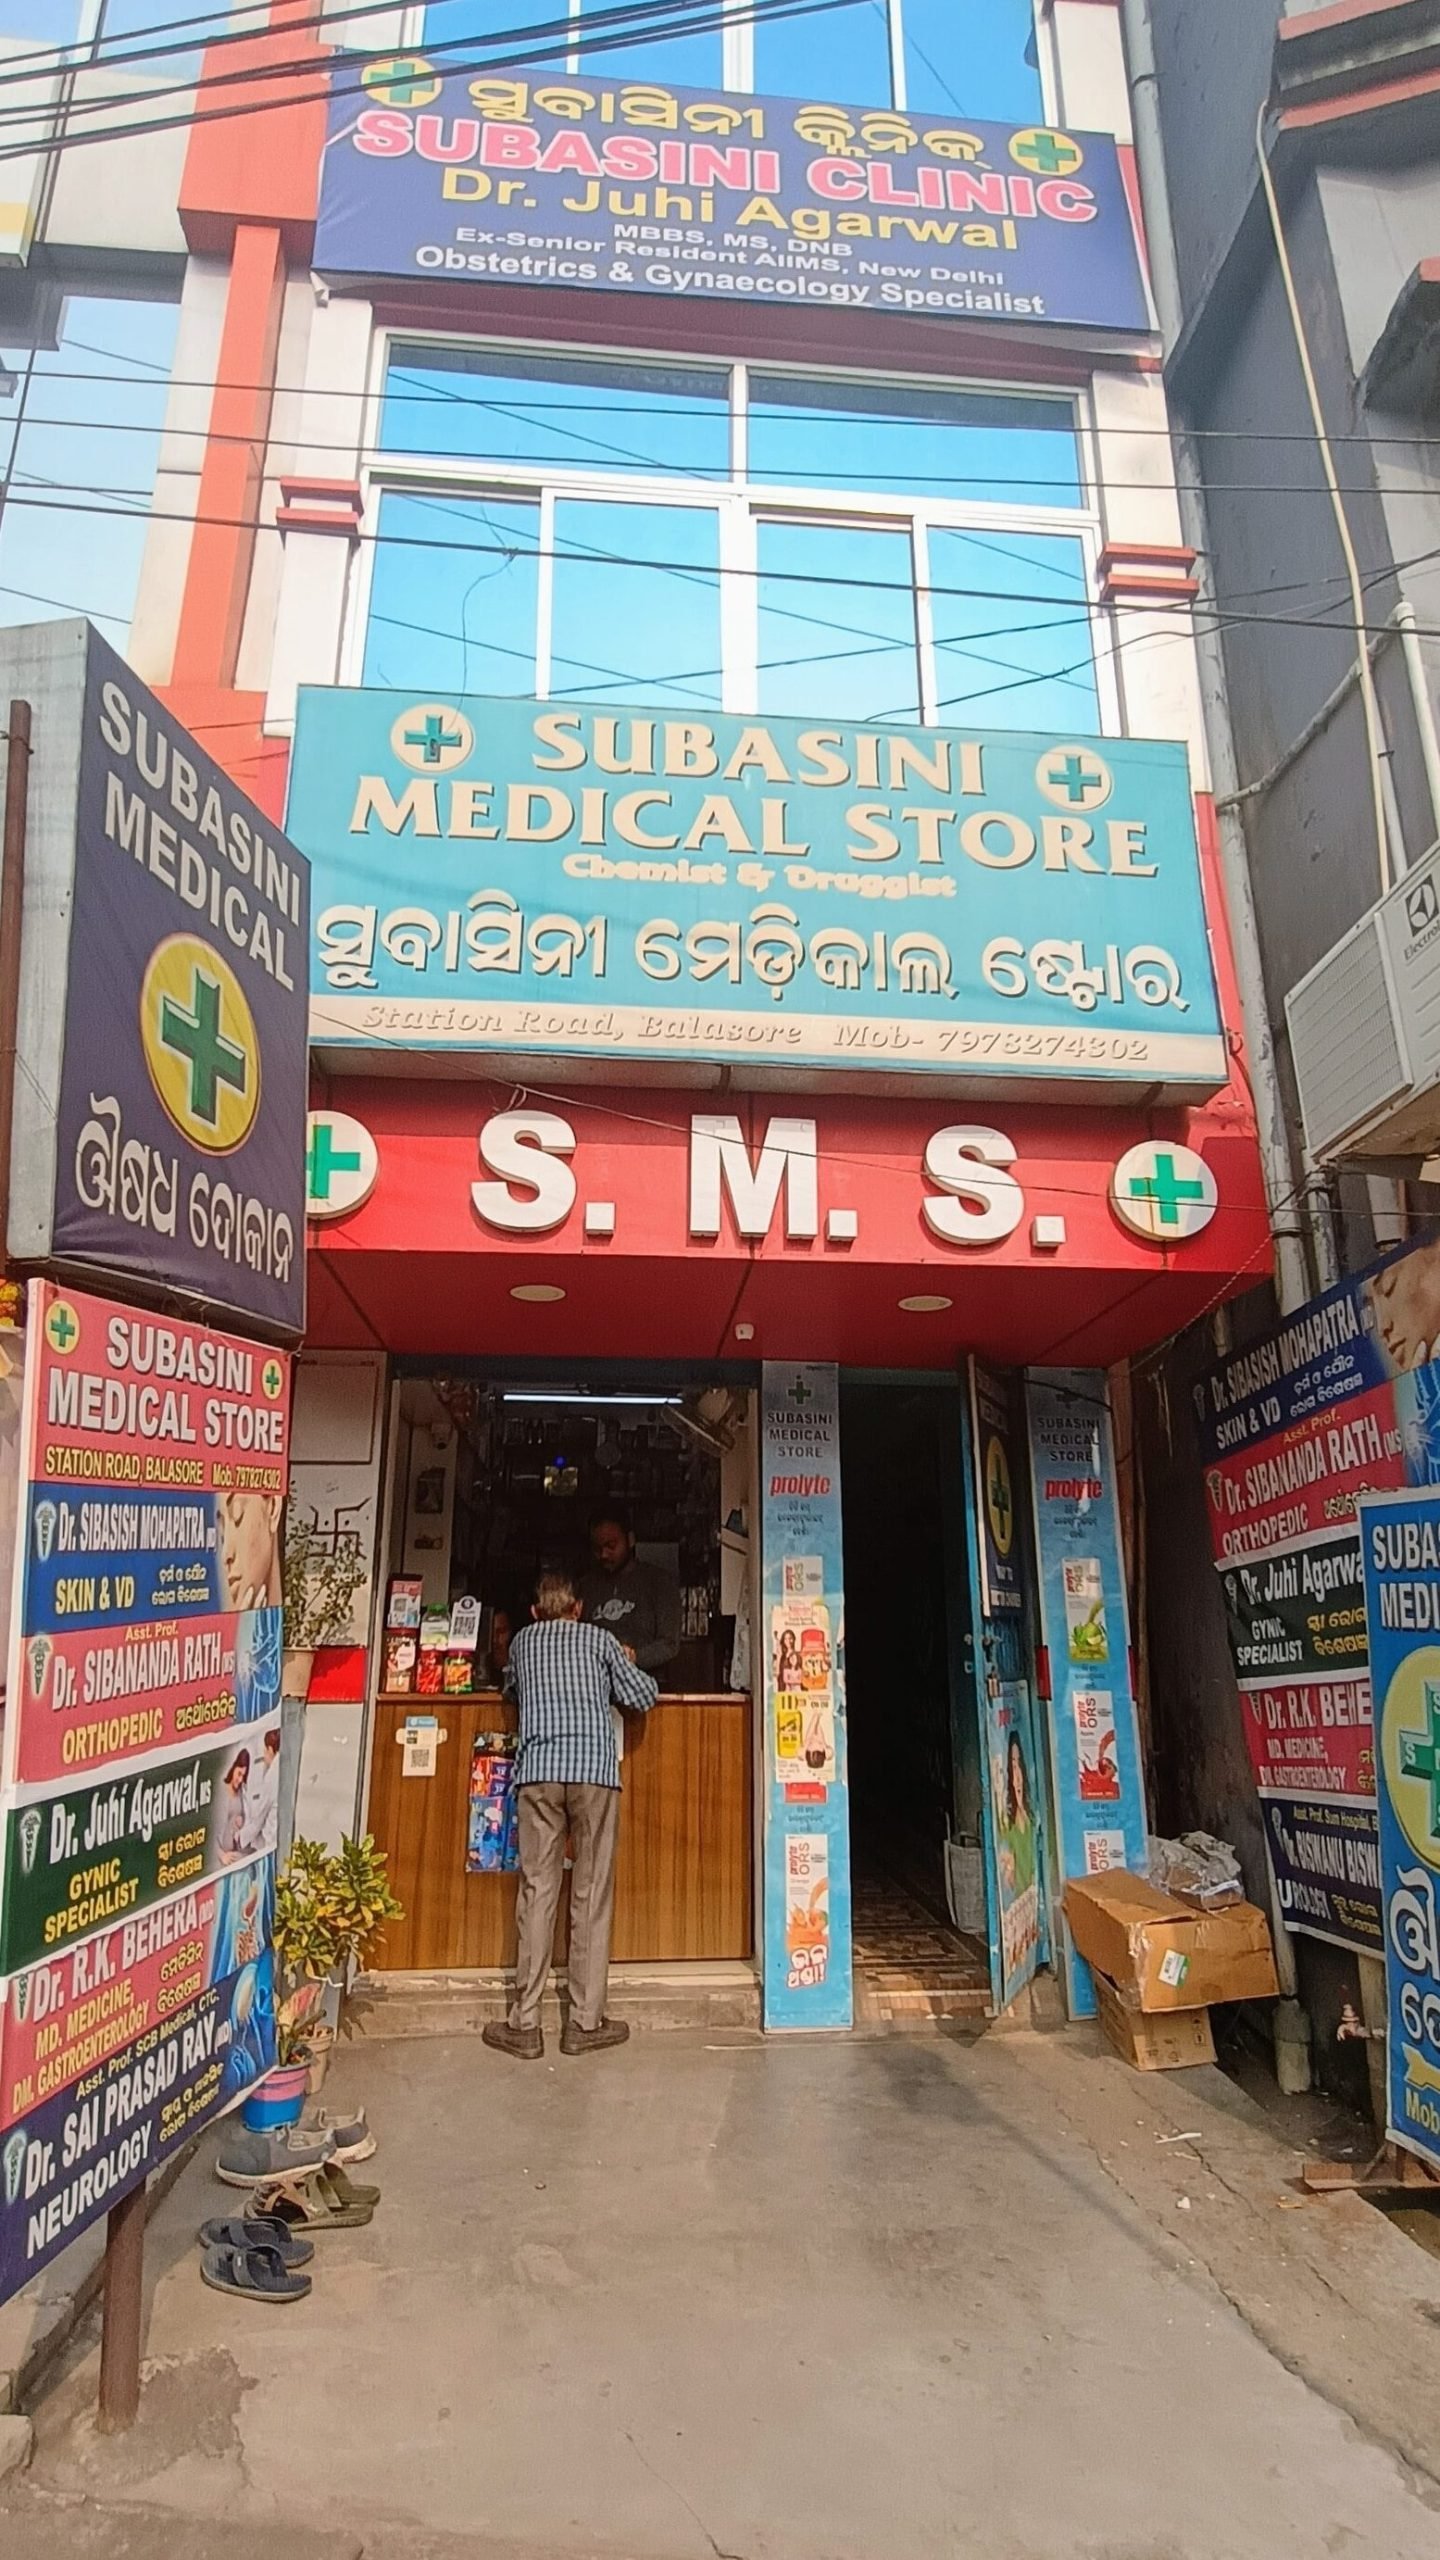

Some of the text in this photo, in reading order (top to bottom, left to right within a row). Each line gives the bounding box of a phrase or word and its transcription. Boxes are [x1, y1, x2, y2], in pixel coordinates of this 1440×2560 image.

[468, 79, 765, 138] ସୁବାସିନୀ
[353, 110, 1098, 223] SUBASINI CLINIC
[442, 167, 1018, 250] Dr. Juhi Agarwal
[456, 227, 1004, 286] Ex-Senior Resident AIIMS, New Delhi
[614, 223, 853, 257] MBBS, MS, DNB
[416, 245, 1046, 315] Obstetrics & Gynaecology Specialist
[531, 712, 987, 796] SUBASINI
[100, 680, 300, 927] SUBASINI
[349, 774, 1159, 878] MEDICAL STORE
[104, 769, 295, 991] MEDICAL
[562, 853, 958, 900] Chemist & Druggist
[316, 888, 608, 989] ସୁବାସିନୀ
[361, 1004, 1148, 1061] Station Road, Balasore Mob- 7978274302
[470, 1110, 1068, 1248] S. M. S.
[188, 1171, 293, 1284] ଦୋକାନ
[106, 1316, 252, 1396] SUBASINI
[1210, 1294, 1360, 1413] Dr. SIBASISH MOHAPATRA
[48, 1367, 284, 1453] MEDICAL STORE
[767, 1412, 833, 1425] SUBASINI
[769, 1429, 831, 1442] MEDICAL
[1037, 1416, 1101, 1430] SUBASINI
[1216, 1396, 1281, 1450] SKIN & VD
[1282, 1408, 1341, 1445] Asst. Prof.
[778, 1446, 823, 1458] STORE
[1039, 1433, 1100, 1446] MEDICAL
[1049, 1450, 1094, 1463] STORE
[1224, 1477, 1246, 1515] Dr.
[1245, 1436, 1329, 1509] SIBANANDA
[1328, 1414, 1384, 1474] RATH
[46, 1447, 281, 1490] STATION ROAD, BALASORE Mob. 7978274302
[769, 1473, 832, 1497] prolyte
[1044, 1478, 1103, 1501] prolyte
[58, 1501, 77, 1551] Dr.
[79, 1502, 138, 1551] SIBASISH
[140, 1505, 206, 1551] MOHAPATRA
[1222, 1503, 1309, 1557] ORTHOPEDIC
[55, 1575, 135, 1614] SKIN & VD
[1240, 1569, 1262, 1605] Dr.
[1264, 1556, 1298, 1602] Juhi
[125, 1620, 179, 1642] Asst. Prof.
[1237, 1640, 1303, 1667] SPECIALIST
[1251, 1617, 1286, 1641] GYNIC
[52, 1631, 222, 1711] Dr. SIBANANDA RATH
[1087, 1697, 1098, 1729] ORS
[1264, 1682, 1372, 1729] Dr. R.K. BEHE
[62, 1707, 164, 1764] ORTHOPEDIC
[1284, 1736, 1328, 1763] MEDICINE,
[1274, 1765, 1346, 1790] GASTROENTEROLOGY
[50, 1802, 78, 1864] Dr.
[84, 1782, 126, 1851] Juhi
[69, 1857, 121, 1900] GYNIC
[799, 1841, 811, 1876] ORS
[1099, 1837, 1109, 1871] ORS
[44, 1878, 139, 1943] SPECIALIST
[33, 1893, 197, 2022] Dr. R.K. BEHERA
[35, 1978, 135, 2061] MD. MEDICINE,
[76, 1989, 220, 2101] Asst. Prof. SCB Medical, CTC.
[13, 1999, 150, 2114] DM. GASTROENTEROLOGY
[25, 2138, 56, 2199] Dr.
[62, 2100, 98, 2169] SAI
[104, 2037, 177, 2137] PRASAD
[182, 2012, 217, 2076] RAY
[26, 2120, 152, 2260] NEUROLOGY
